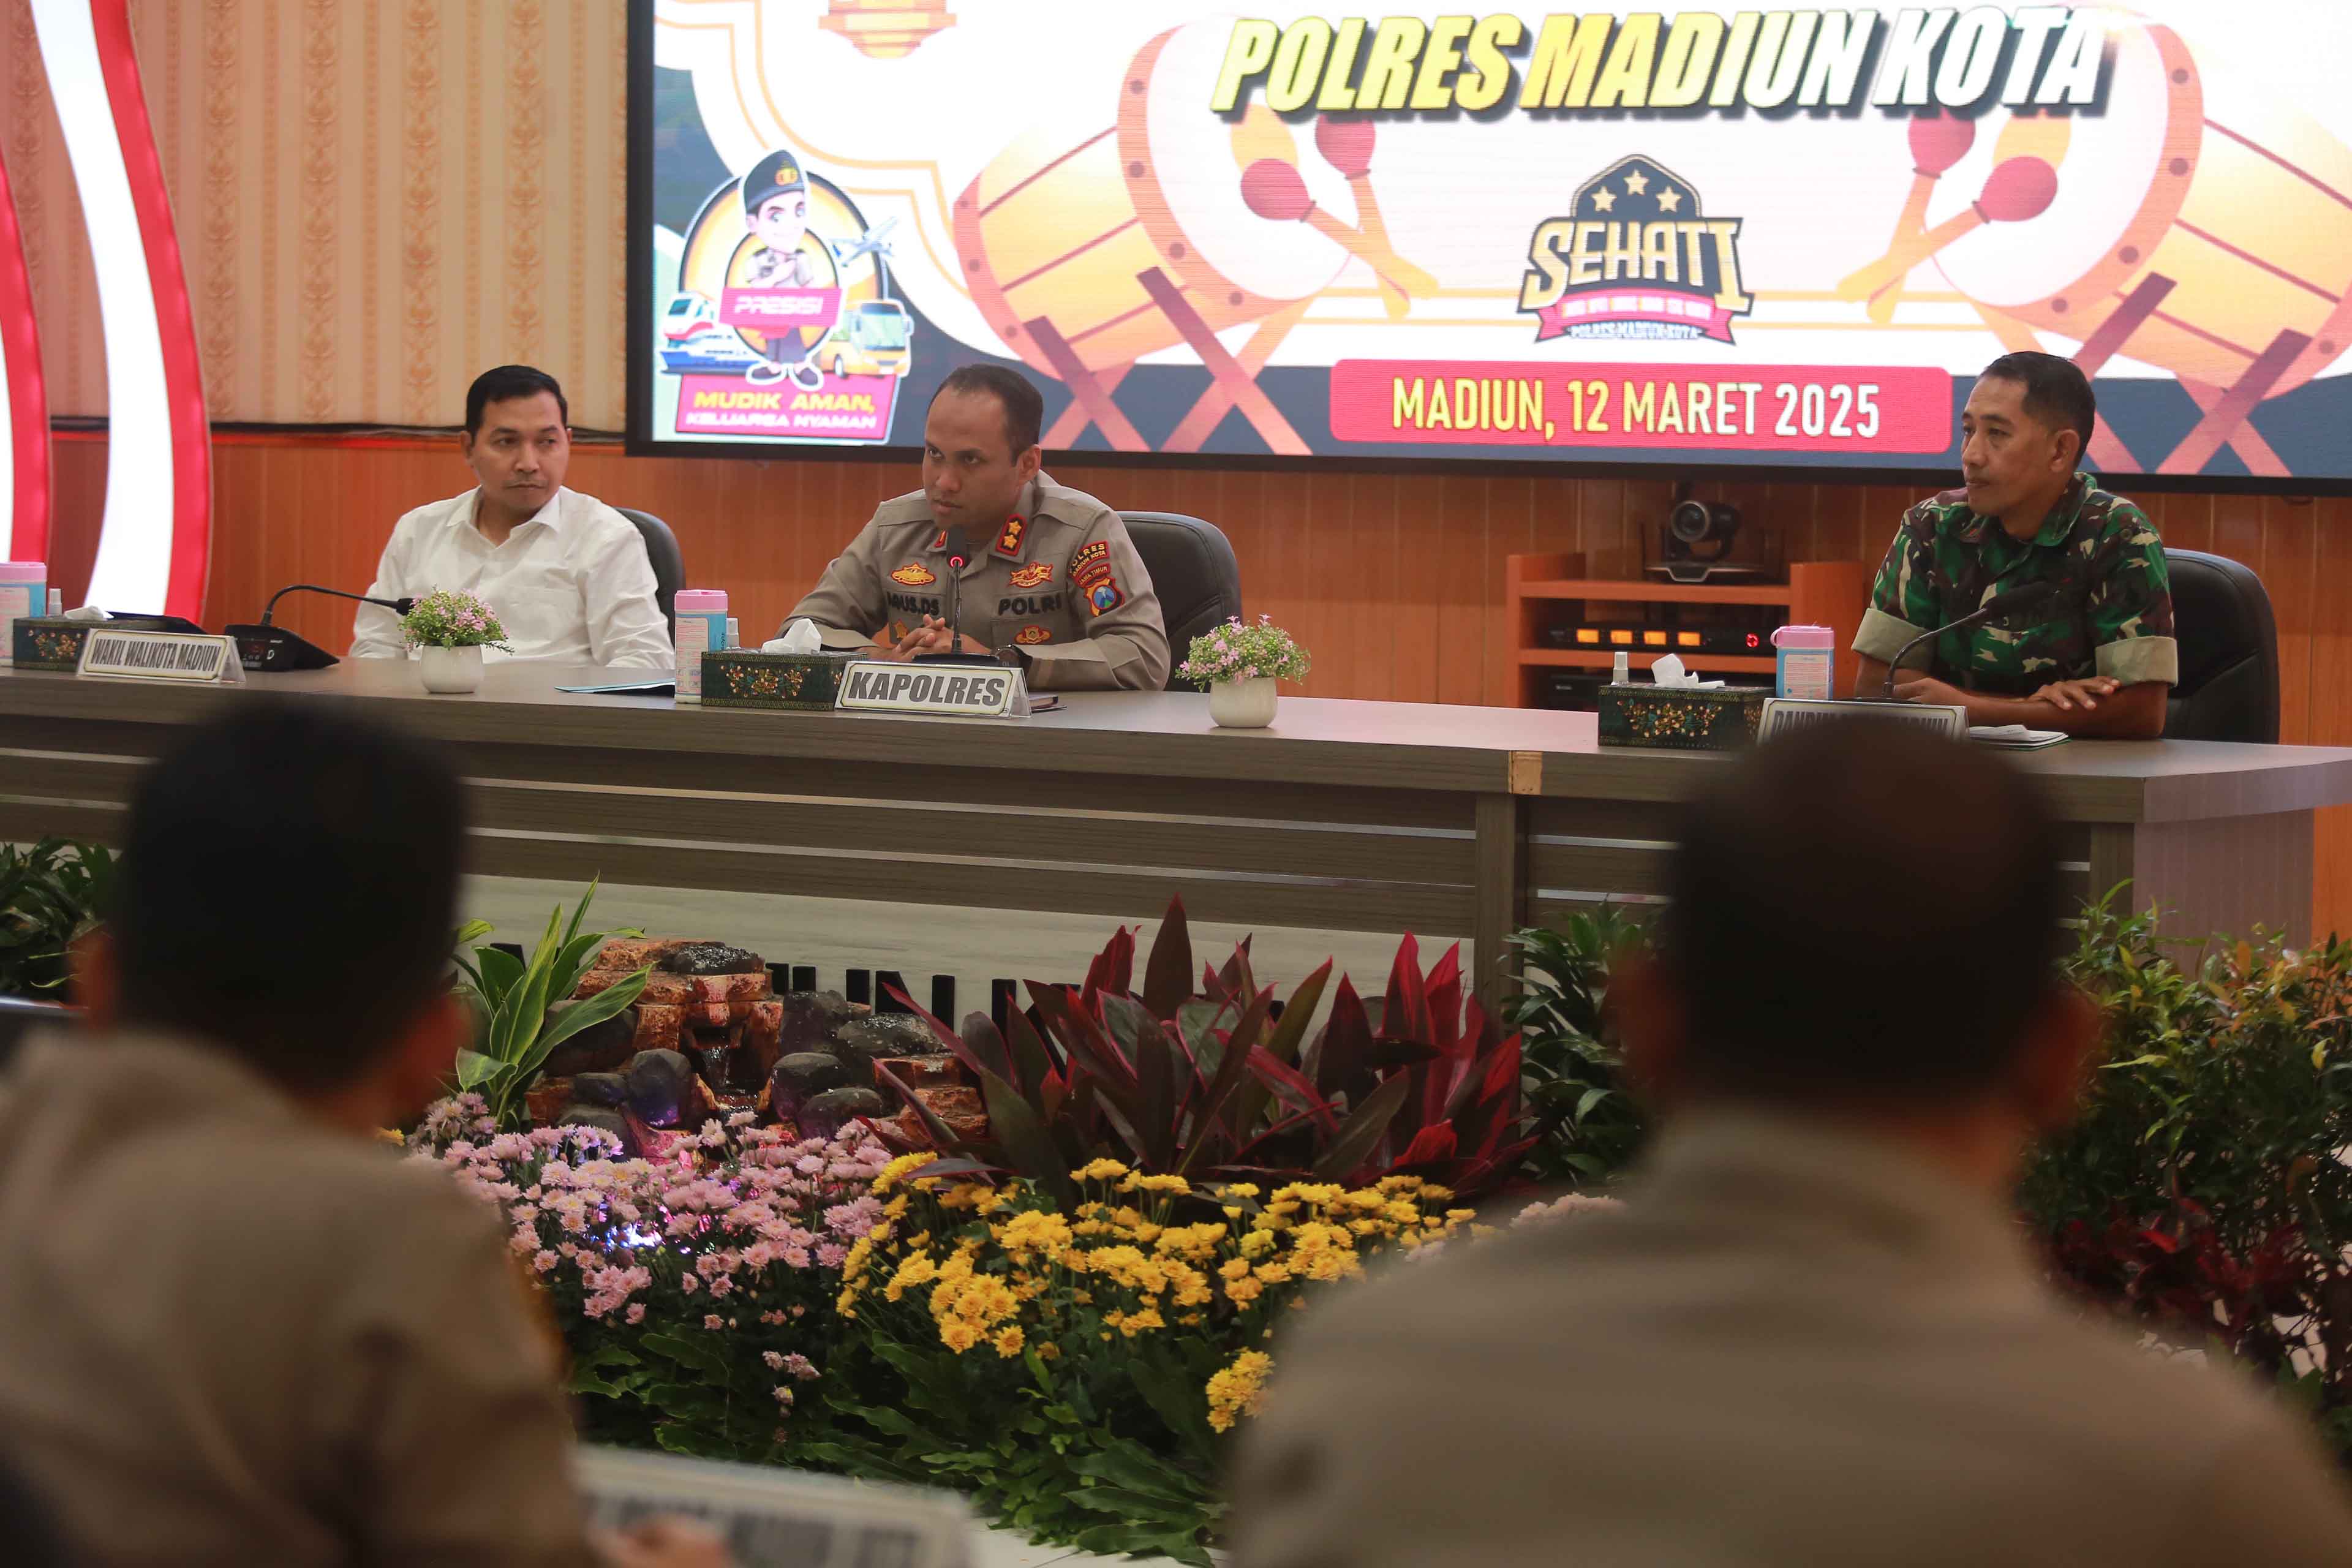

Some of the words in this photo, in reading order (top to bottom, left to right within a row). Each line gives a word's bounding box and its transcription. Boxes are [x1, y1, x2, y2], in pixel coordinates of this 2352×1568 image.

[1210, 13, 1524, 114] POLRES
[1519, 10, 1877, 110] MADIUN
[1872, 6, 2111, 107] KOTA
[1521, 221, 1751, 313] SEHATI
[694, 391, 782, 410] MUDIK
[790, 393, 875, 413] AMAN,
[1392, 376, 1555, 442] MADIUN,
[1567, 380, 1610, 433] 12
[1622, 381, 1763, 435] MARET
[1774, 384, 1880, 438] 2025
[793, 415, 877, 429] NYAMAN
[1090, 550, 1106, 559] KOTA
[1091, 566, 1108, 575] TIMUR
[998, 594, 1063, 616] POLRI
[91, 638, 126, 666] WAKIL
[124, 641, 178, 669] WALIKOTA
[175, 643, 222, 672] MADIUN
[847, 671, 1005, 706] KAPOLRES
